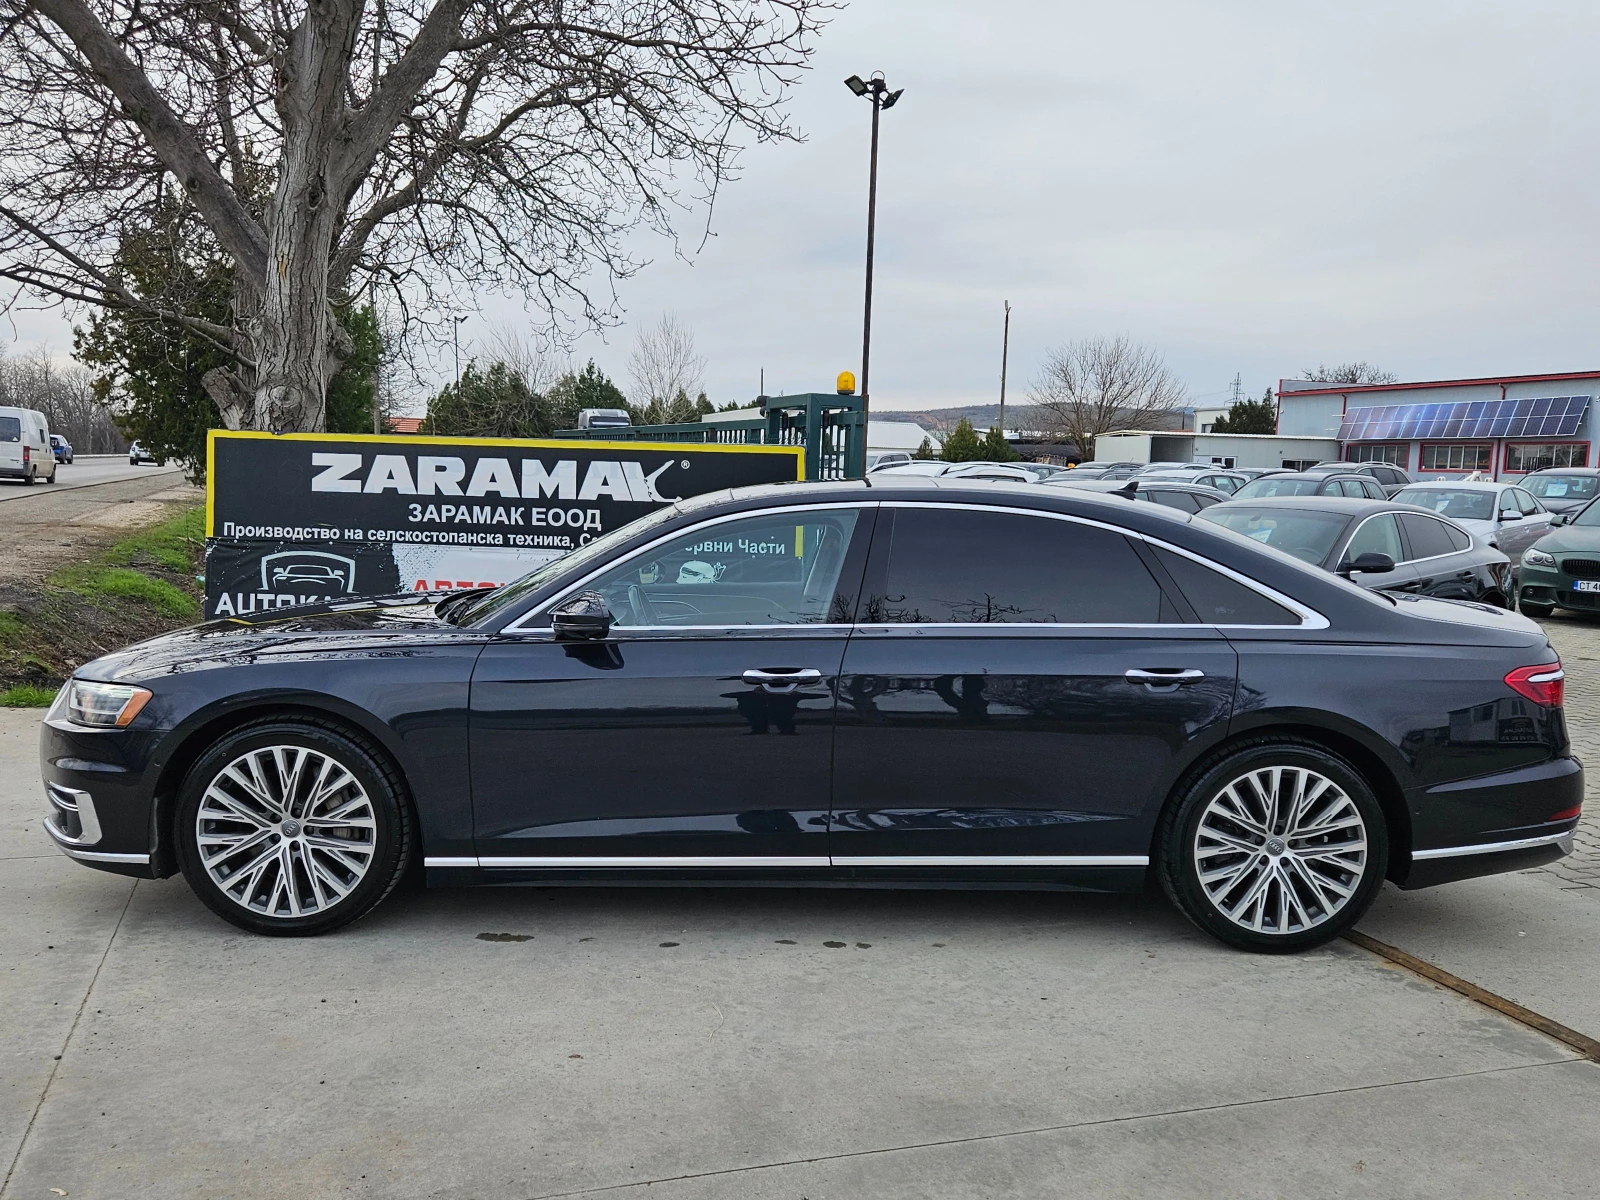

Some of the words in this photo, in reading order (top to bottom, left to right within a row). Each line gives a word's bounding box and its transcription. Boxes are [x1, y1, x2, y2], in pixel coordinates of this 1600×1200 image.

[408, 503, 525, 526] ЗАРАМАК
[531, 507, 602, 531] ЕООД
[223, 521, 340, 541] Производство
[344, 529, 363, 540] на
[367, 530, 503, 545] селскостопанска
[507, 534, 574, 549] техника,
[738, 539, 785, 555] Части
